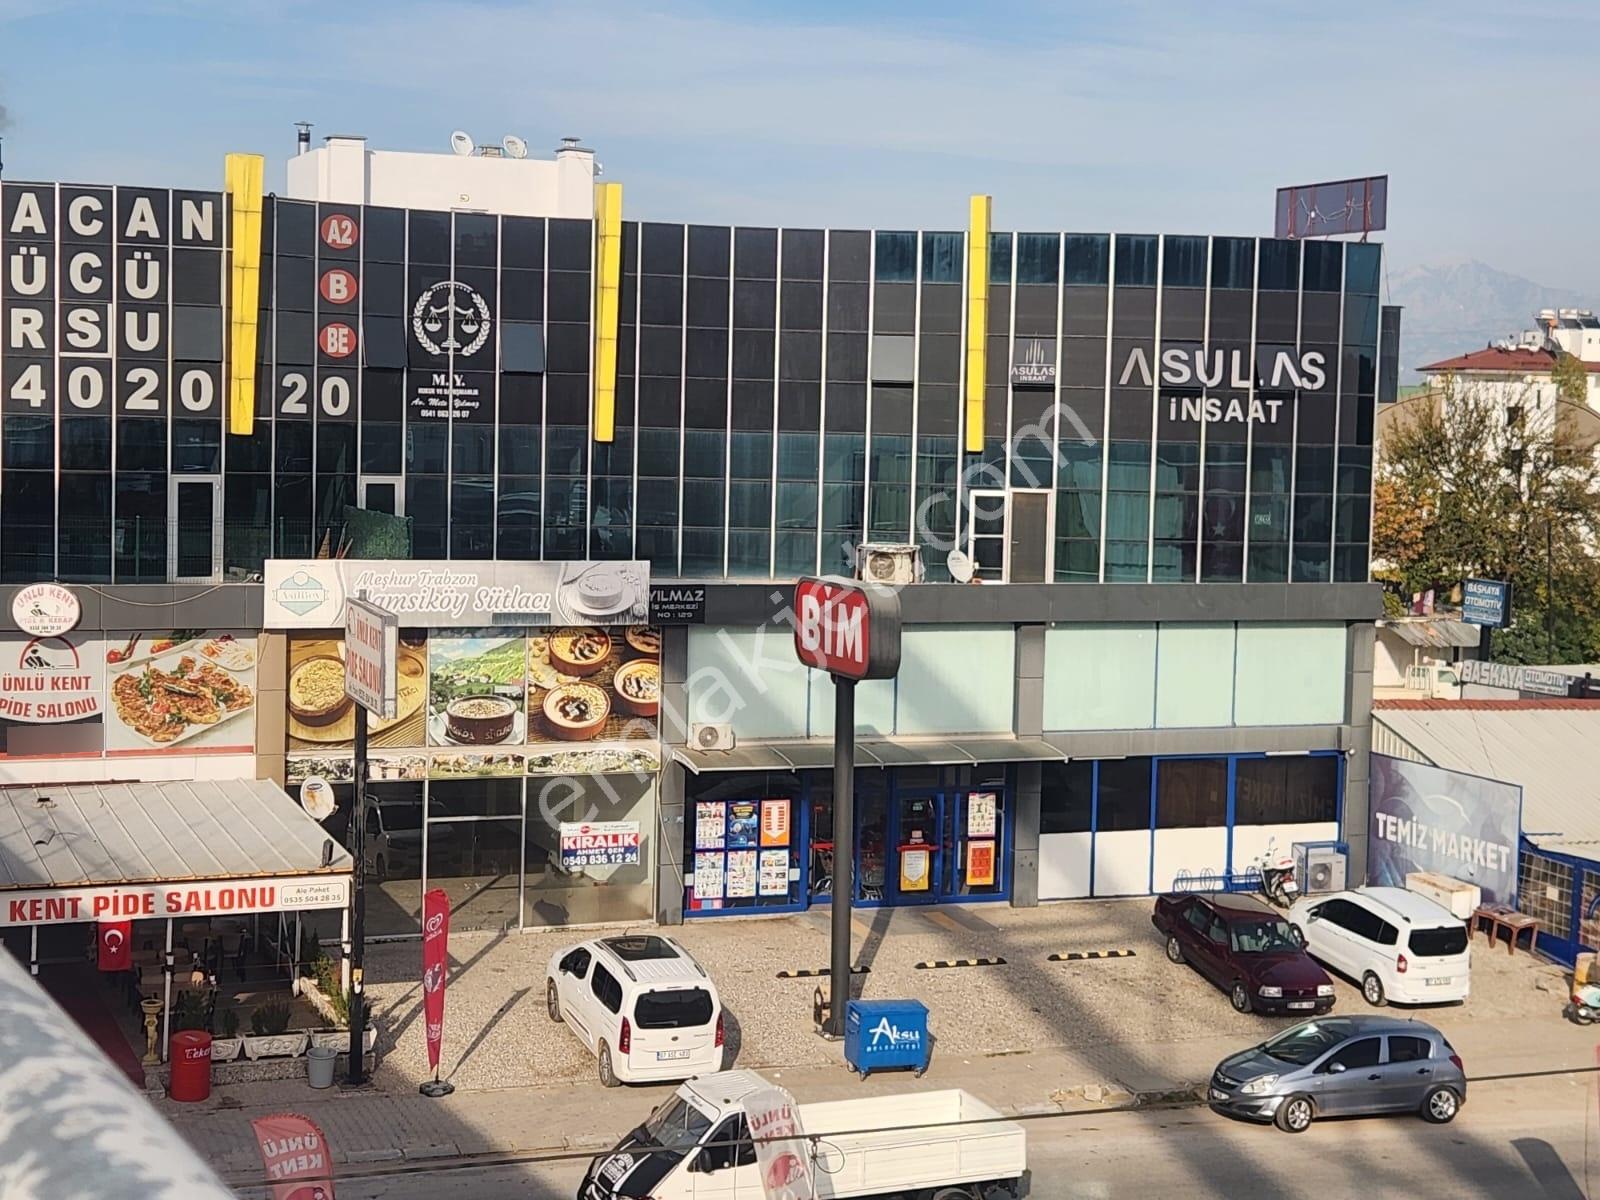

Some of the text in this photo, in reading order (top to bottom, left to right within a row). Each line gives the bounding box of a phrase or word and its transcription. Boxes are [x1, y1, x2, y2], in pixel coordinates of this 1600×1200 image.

[327, 219, 353, 245] A2
[329, 273, 348, 300] B
[327, 327, 349, 354] BE
[356, 570, 478, 589] Meşhur Trabzon
[356, 586, 550, 617] amsiköy Sütlacı
[649, 590, 704, 602] YILMAZ
[801, 586, 863, 663] BİM
[3, 673, 91, 691] ÜNLÜ KENT
[0, 696, 97, 718] PİDE SALONU
[563, 833, 638, 850] KIRALIK
[1376, 812, 1510, 873] TEMİZ MARKET
[562, 855, 588, 866] 0549
[611, 853, 622, 864] 12
[625, 853, 638, 862] 24
[10, 886, 275, 922] KENT PİDE SALONU
[869, 1016, 920, 1045] Aksu
